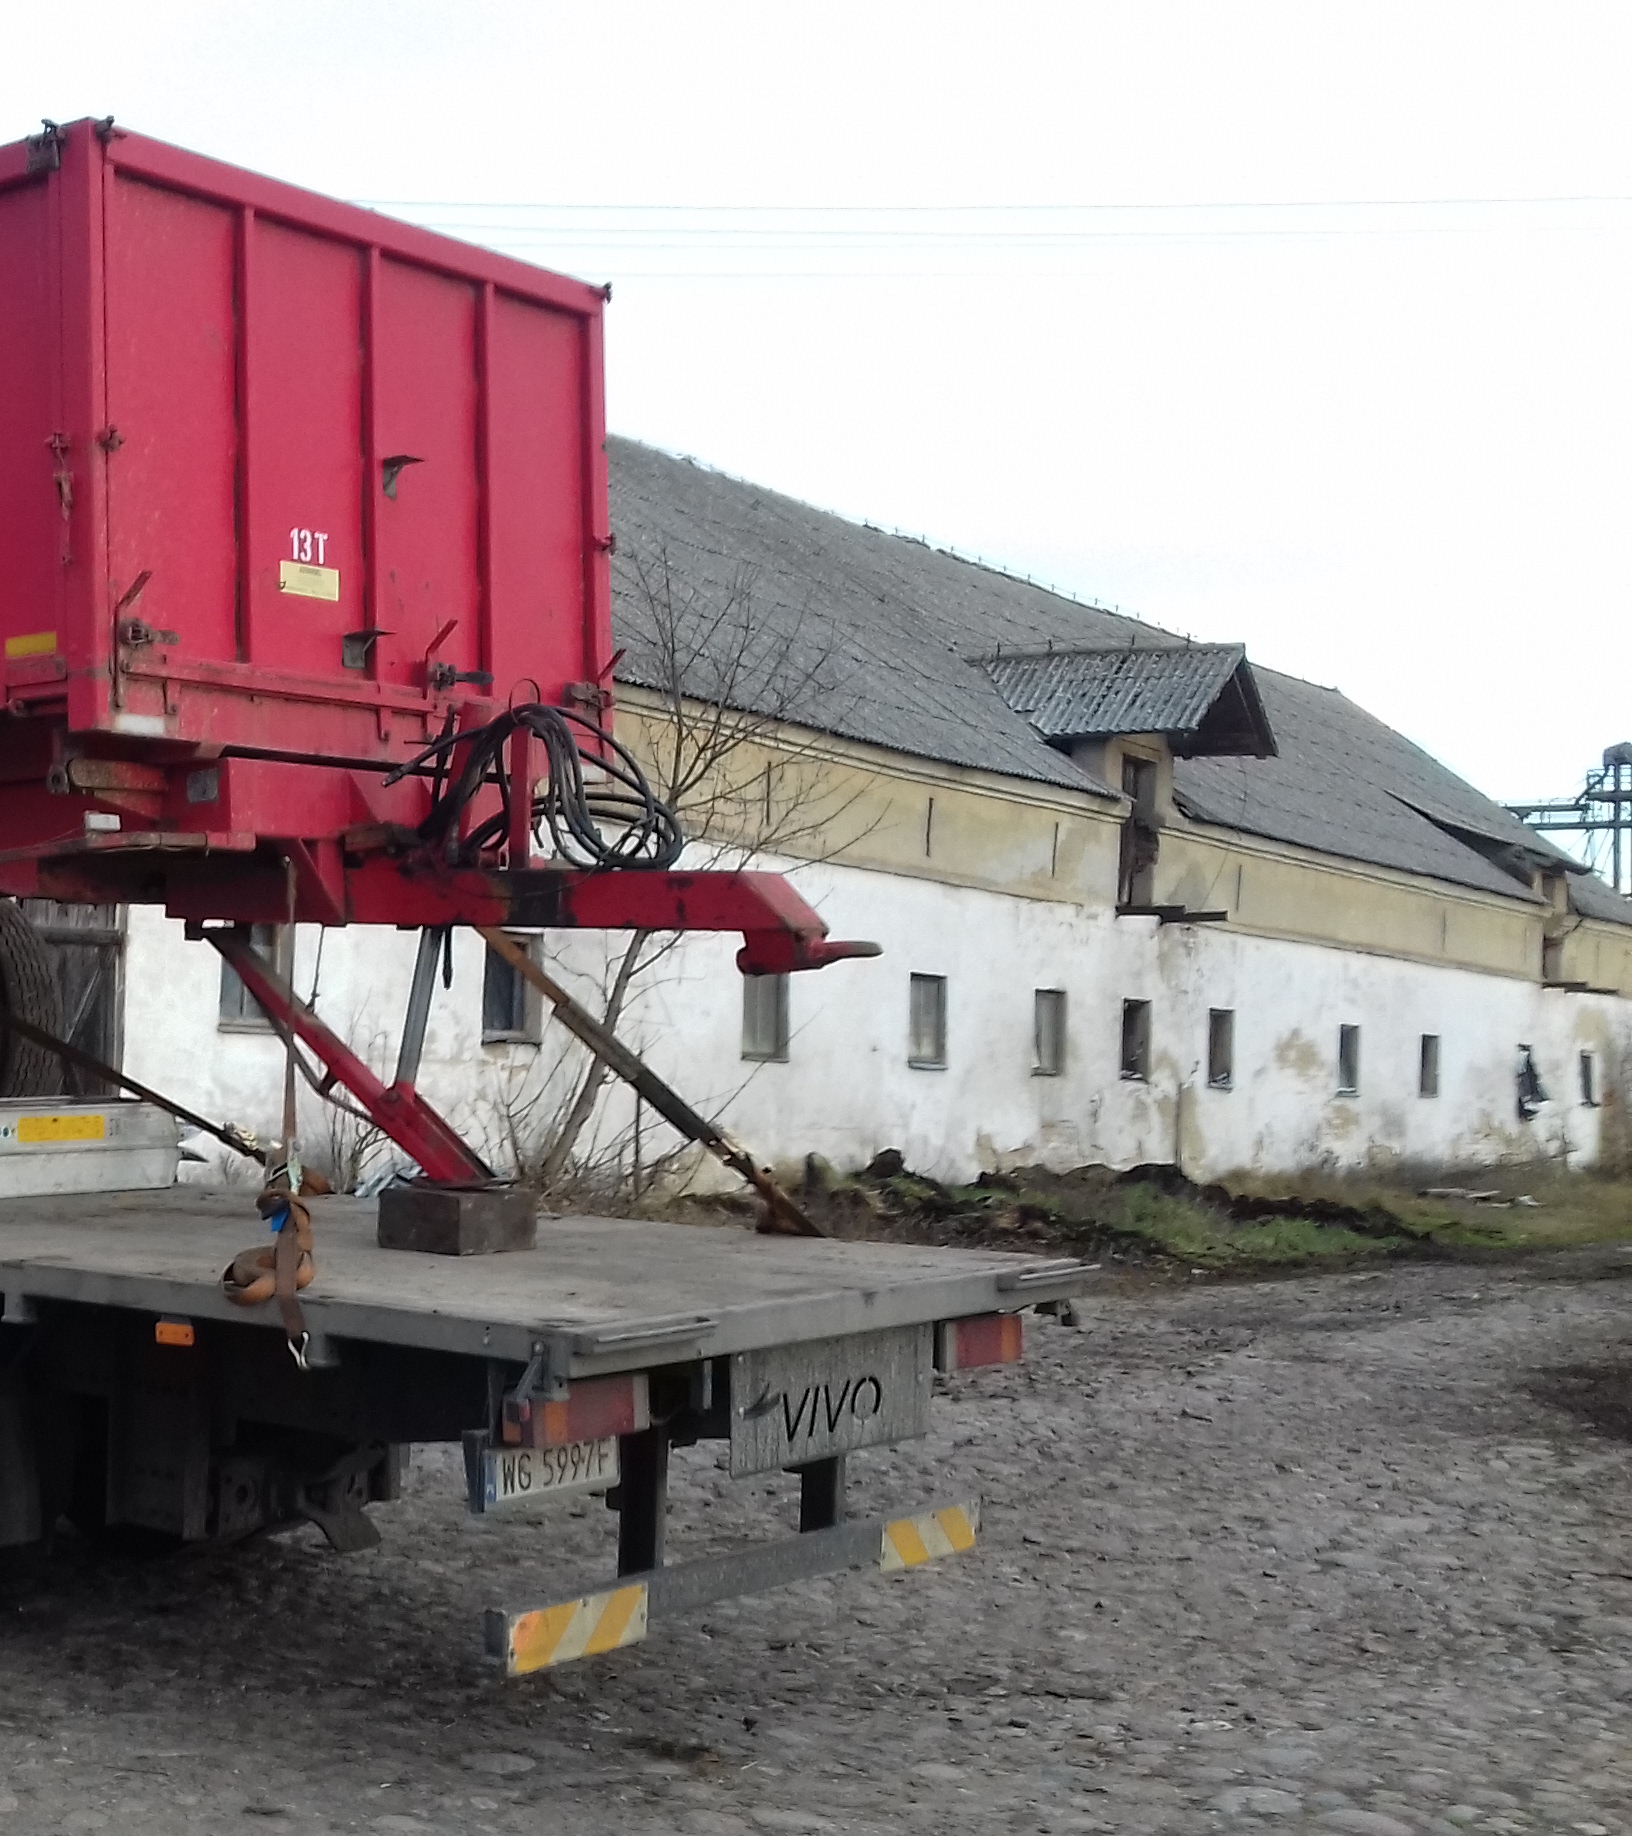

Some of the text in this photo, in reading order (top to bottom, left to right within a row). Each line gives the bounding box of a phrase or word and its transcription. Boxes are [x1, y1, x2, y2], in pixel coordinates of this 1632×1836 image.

[782, 1376, 882, 1442] VIVO
[502, 1437, 608, 1495] WG 5997F
